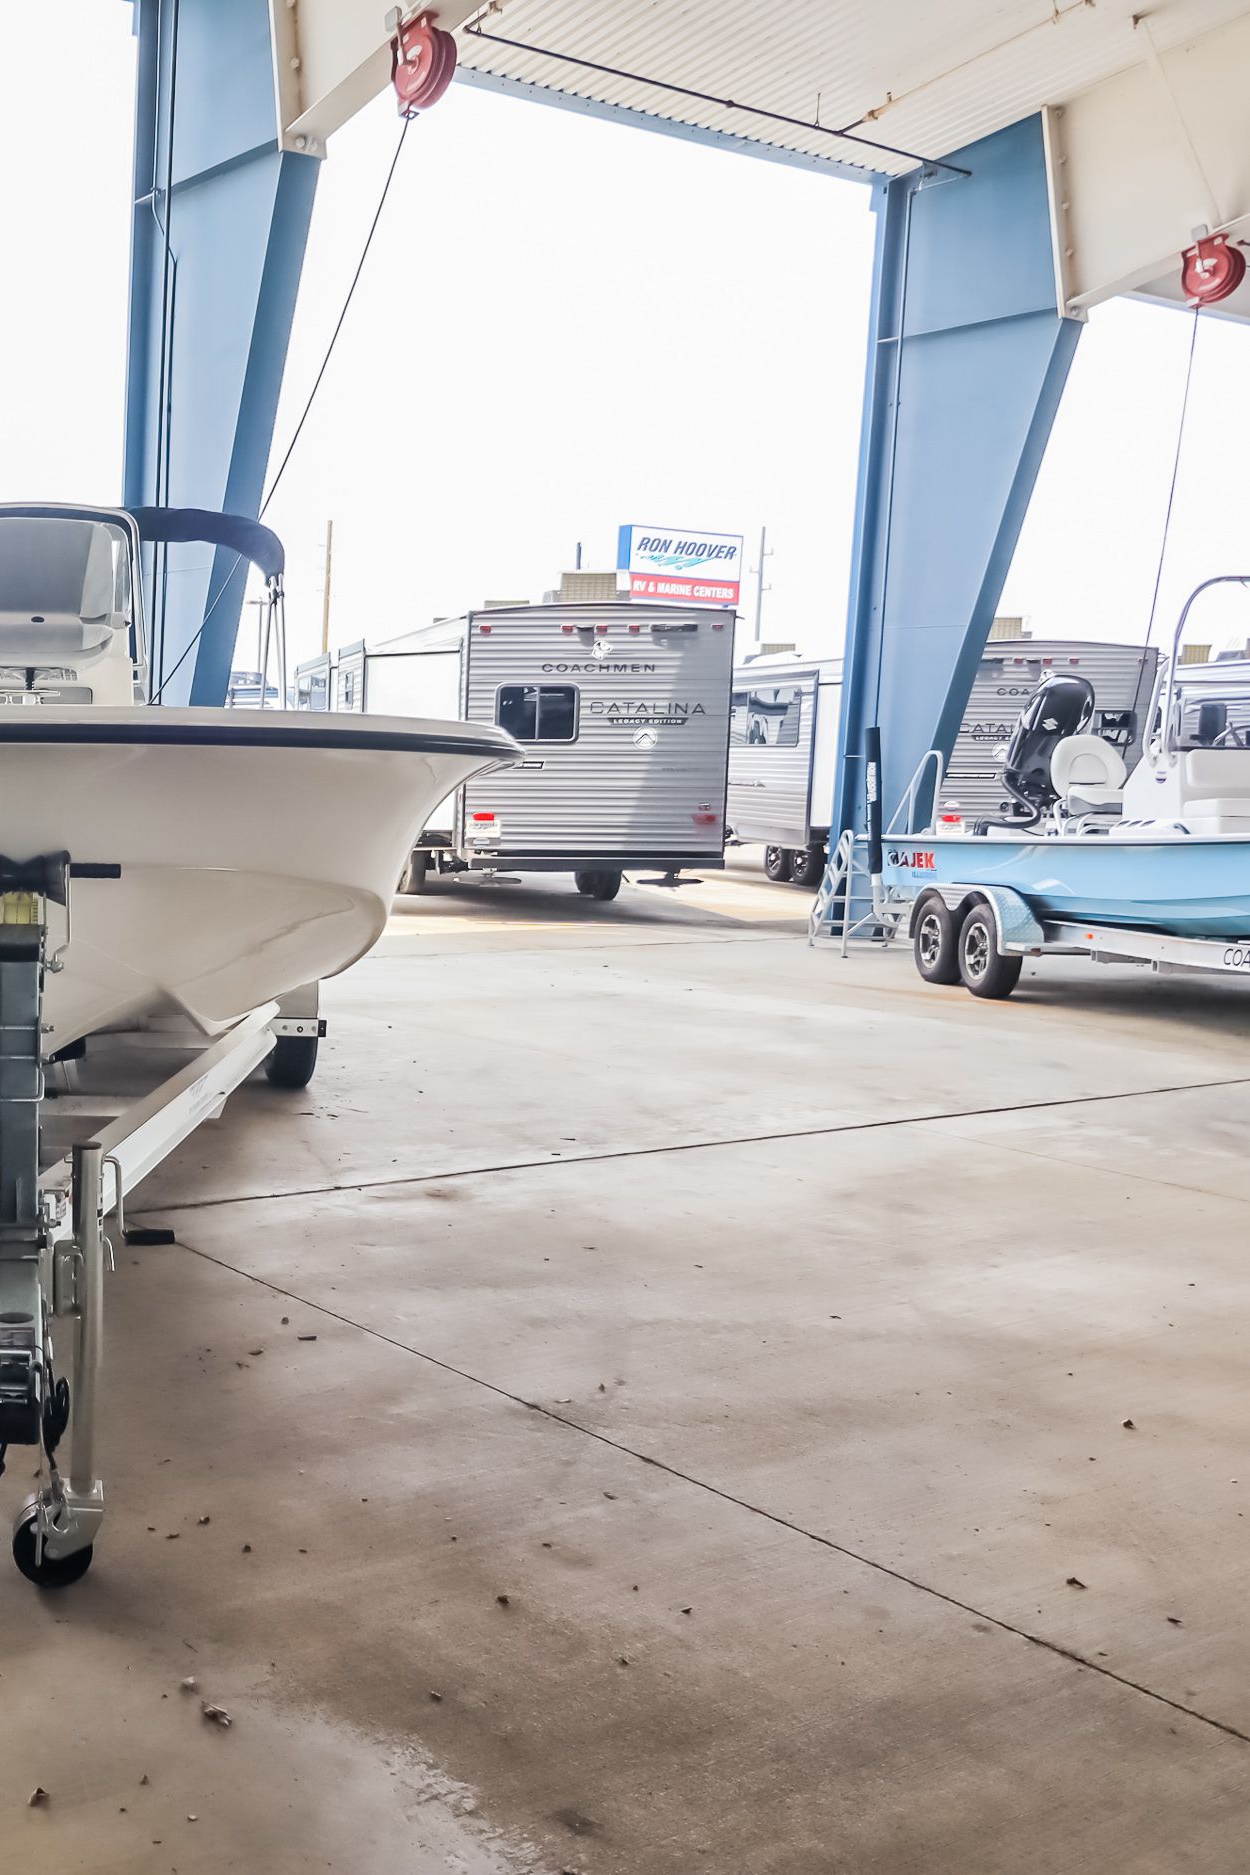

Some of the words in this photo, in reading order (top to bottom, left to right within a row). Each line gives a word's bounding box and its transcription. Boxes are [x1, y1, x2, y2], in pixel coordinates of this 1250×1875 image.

[637, 537, 672, 553] RON
[673, 541, 737, 560] HOOVER
[633, 580, 646, 592] RV
[647, 581, 655, 592] &
[657, 582, 692, 596] MARINE
[693, 585, 734, 599] CENTERS
[541, 663, 655, 673] COACHMEN
[590, 701, 706, 715] CATALINA
